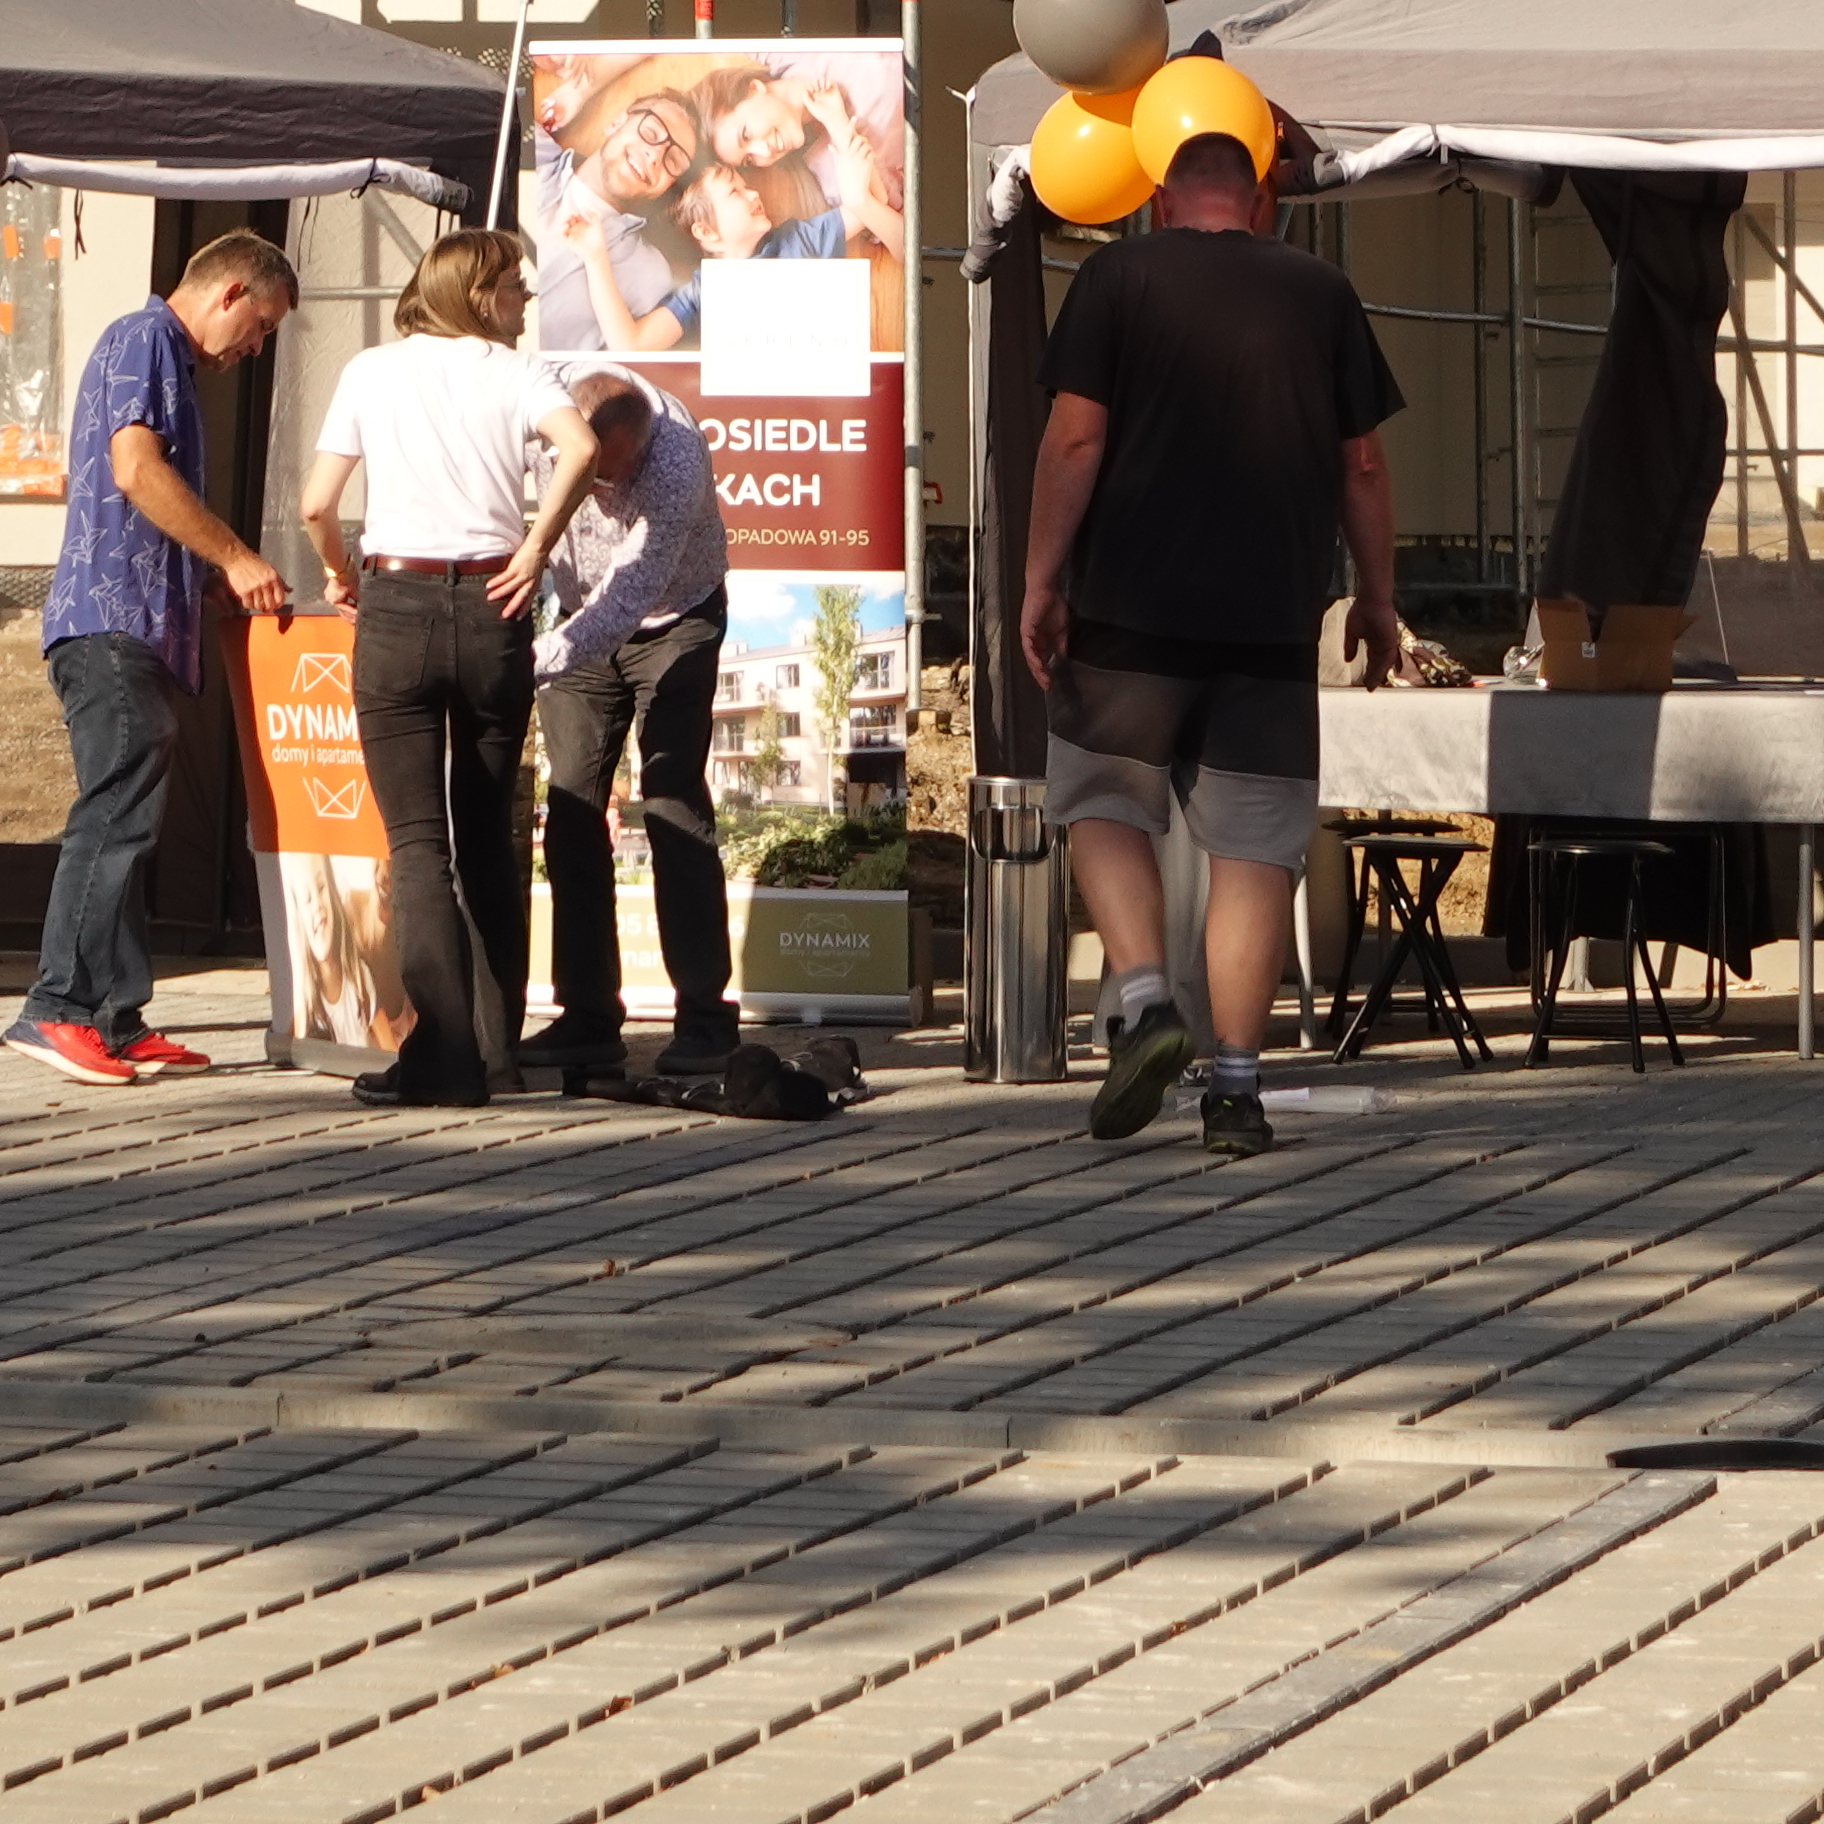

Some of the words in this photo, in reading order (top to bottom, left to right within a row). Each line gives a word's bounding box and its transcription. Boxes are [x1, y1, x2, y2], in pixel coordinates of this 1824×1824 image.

[699, 418, 867, 452] OSIEDLE
[714, 473, 821, 507] KACH
[726, 528, 817, 546] OPADOWA
[819, 529, 870, 547] 91-95
[267, 703, 359, 742] DYNAM
[272, 742, 309, 768] domy
[310, 743, 316, 762] i
[316, 747, 365, 767] apartame
[779, 932, 871, 948] DYNAMIX
